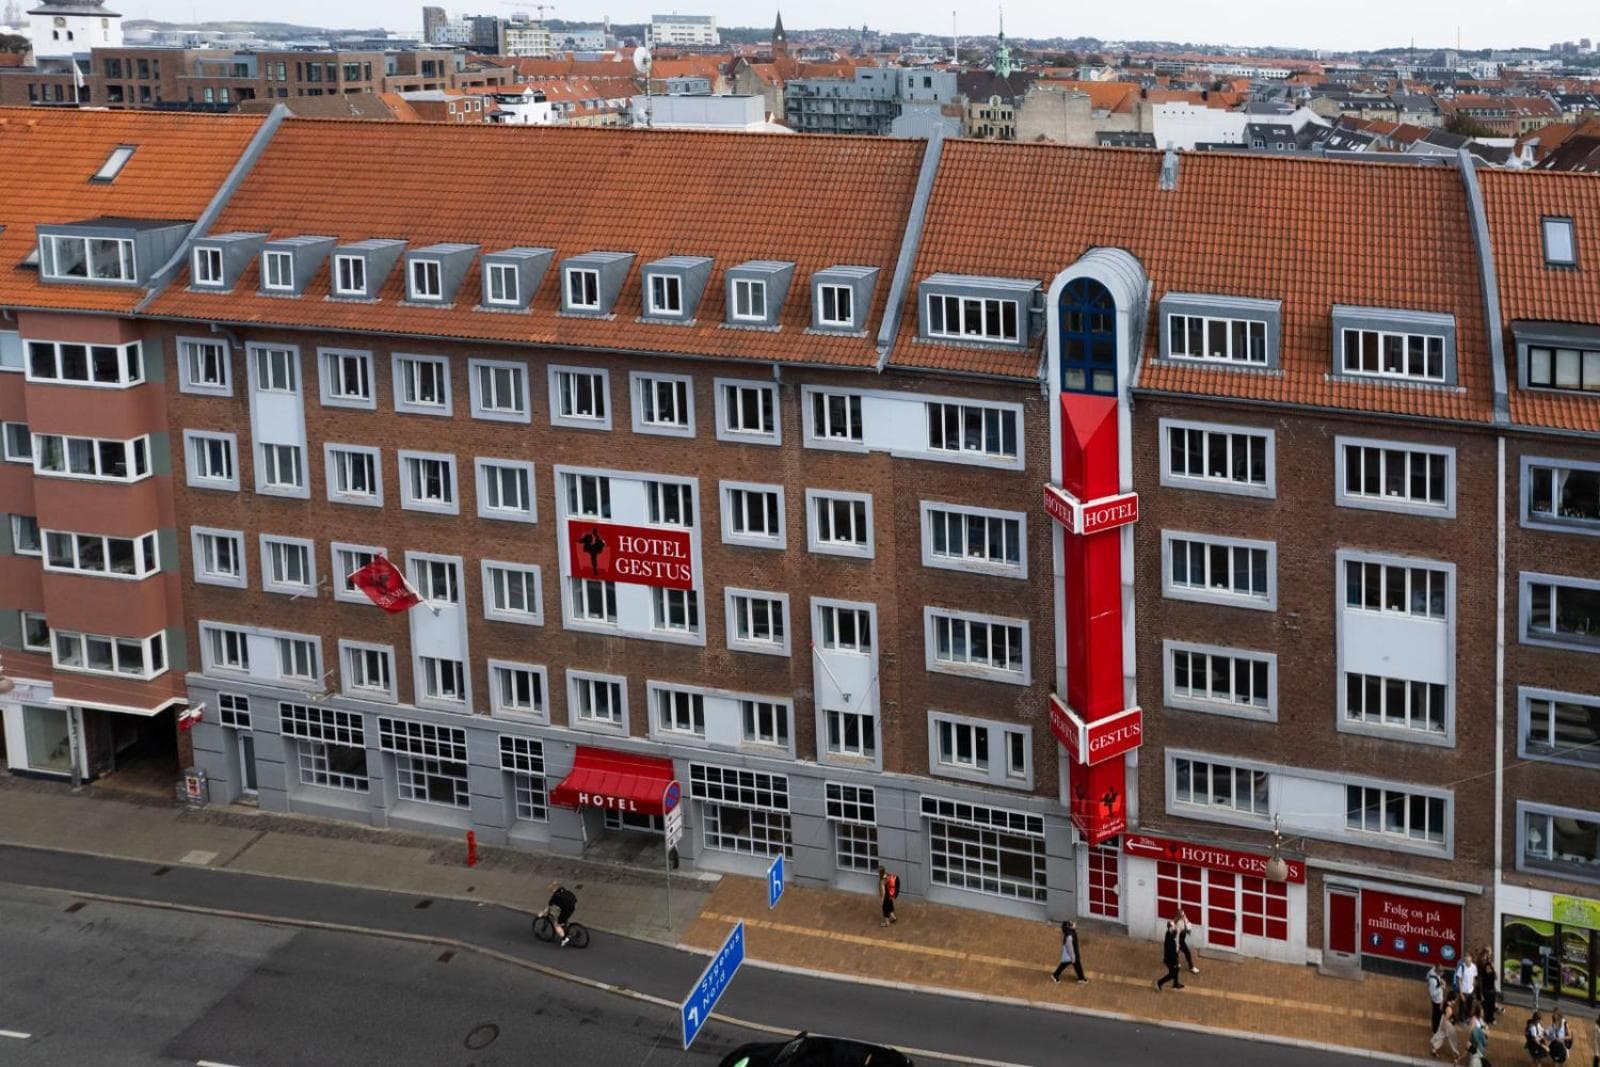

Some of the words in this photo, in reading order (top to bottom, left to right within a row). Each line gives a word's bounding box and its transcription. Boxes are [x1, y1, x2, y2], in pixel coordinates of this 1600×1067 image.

[1045, 494, 1074, 525] HOTEL
[1085, 503, 1136, 527] HOTEL
[618, 535, 687, 559] HOTEL
[615, 558, 691, 581] GESTUS
[1089, 722, 1140, 752] GESTUS
[578, 792, 637, 811] HOTEL
[1181, 847, 1234, 868] HOTEL
[1238, 857, 1298, 878] GESS
[1411, 908, 1423, 919] os
[1426, 909, 1440, 923] på
[1368, 916, 1456, 941] millinghotels.dk
[701, 933, 740, 992] Sygehus
[703, 969, 725, 1010] Nord
